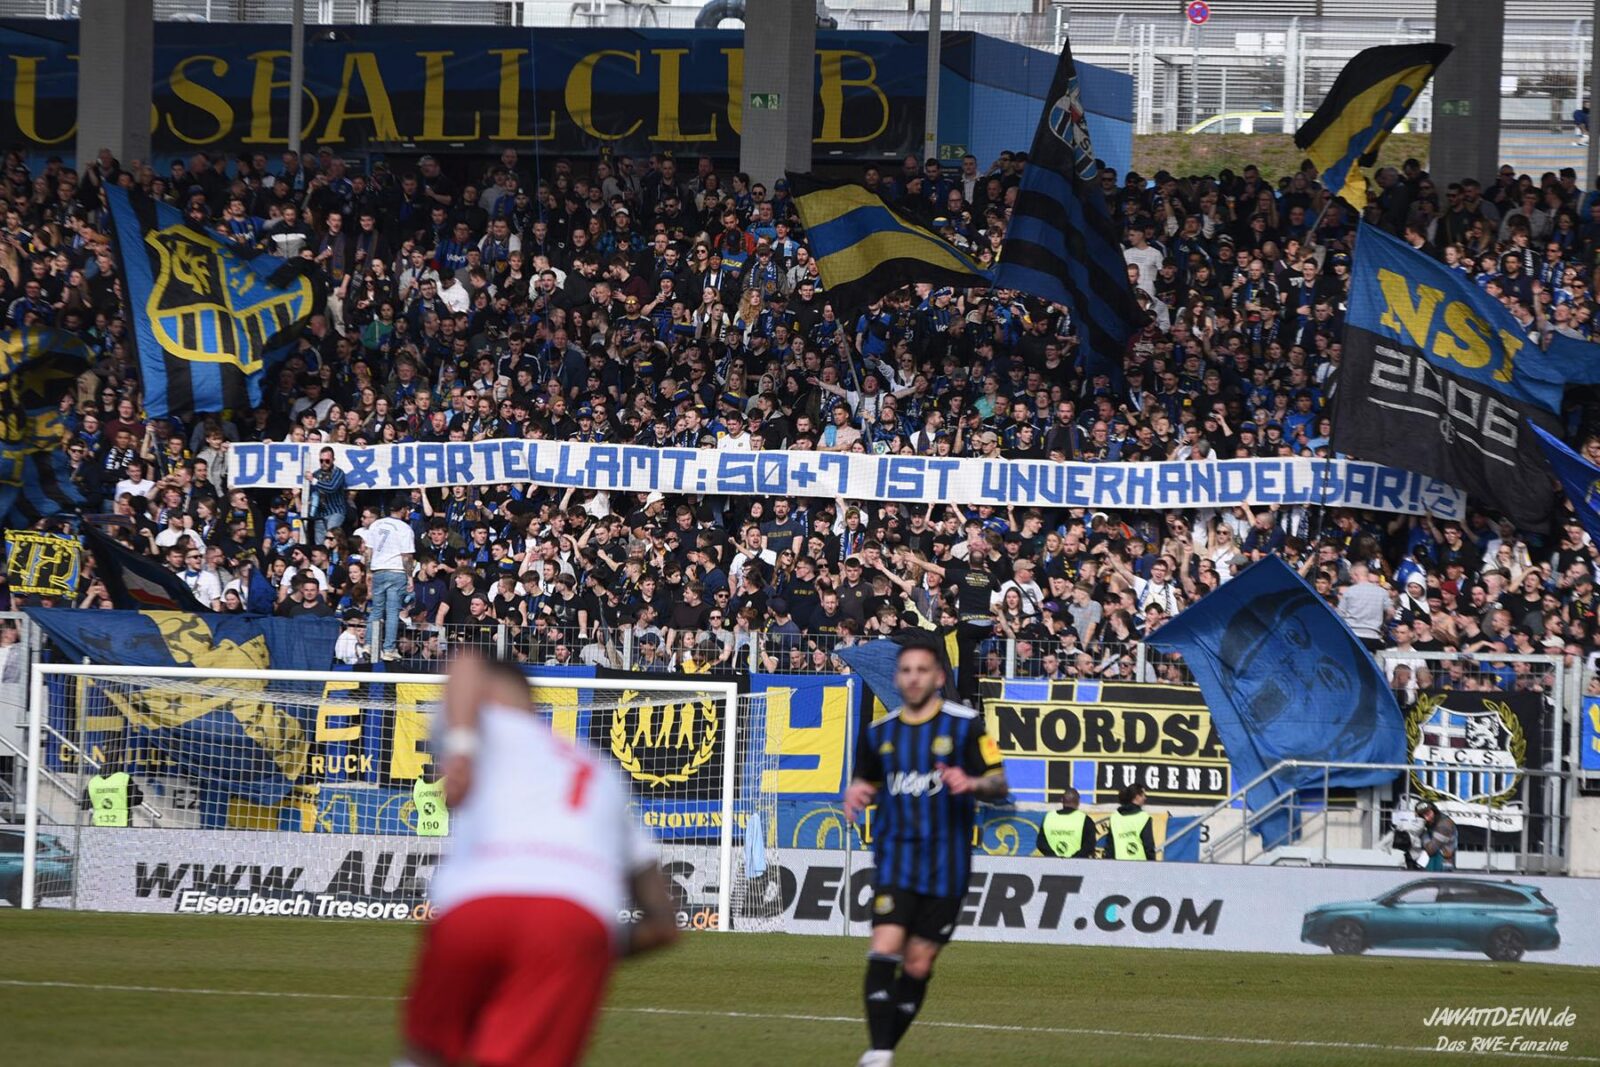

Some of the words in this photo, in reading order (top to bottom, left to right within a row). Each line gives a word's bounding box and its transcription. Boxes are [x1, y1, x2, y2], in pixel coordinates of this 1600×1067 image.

[1370, 344, 1521, 449] 2006
[344, 449, 376, 488] &
[390, 442, 707, 491] KARTELLAMT:
[875, 457, 959, 502] IST
[1104, 765, 1224, 791] JUGEND
[422, 821, 440, 830] 190
[178, 891, 311, 916] Eisenbach
[315, 895, 441, 921] Tresore.de
